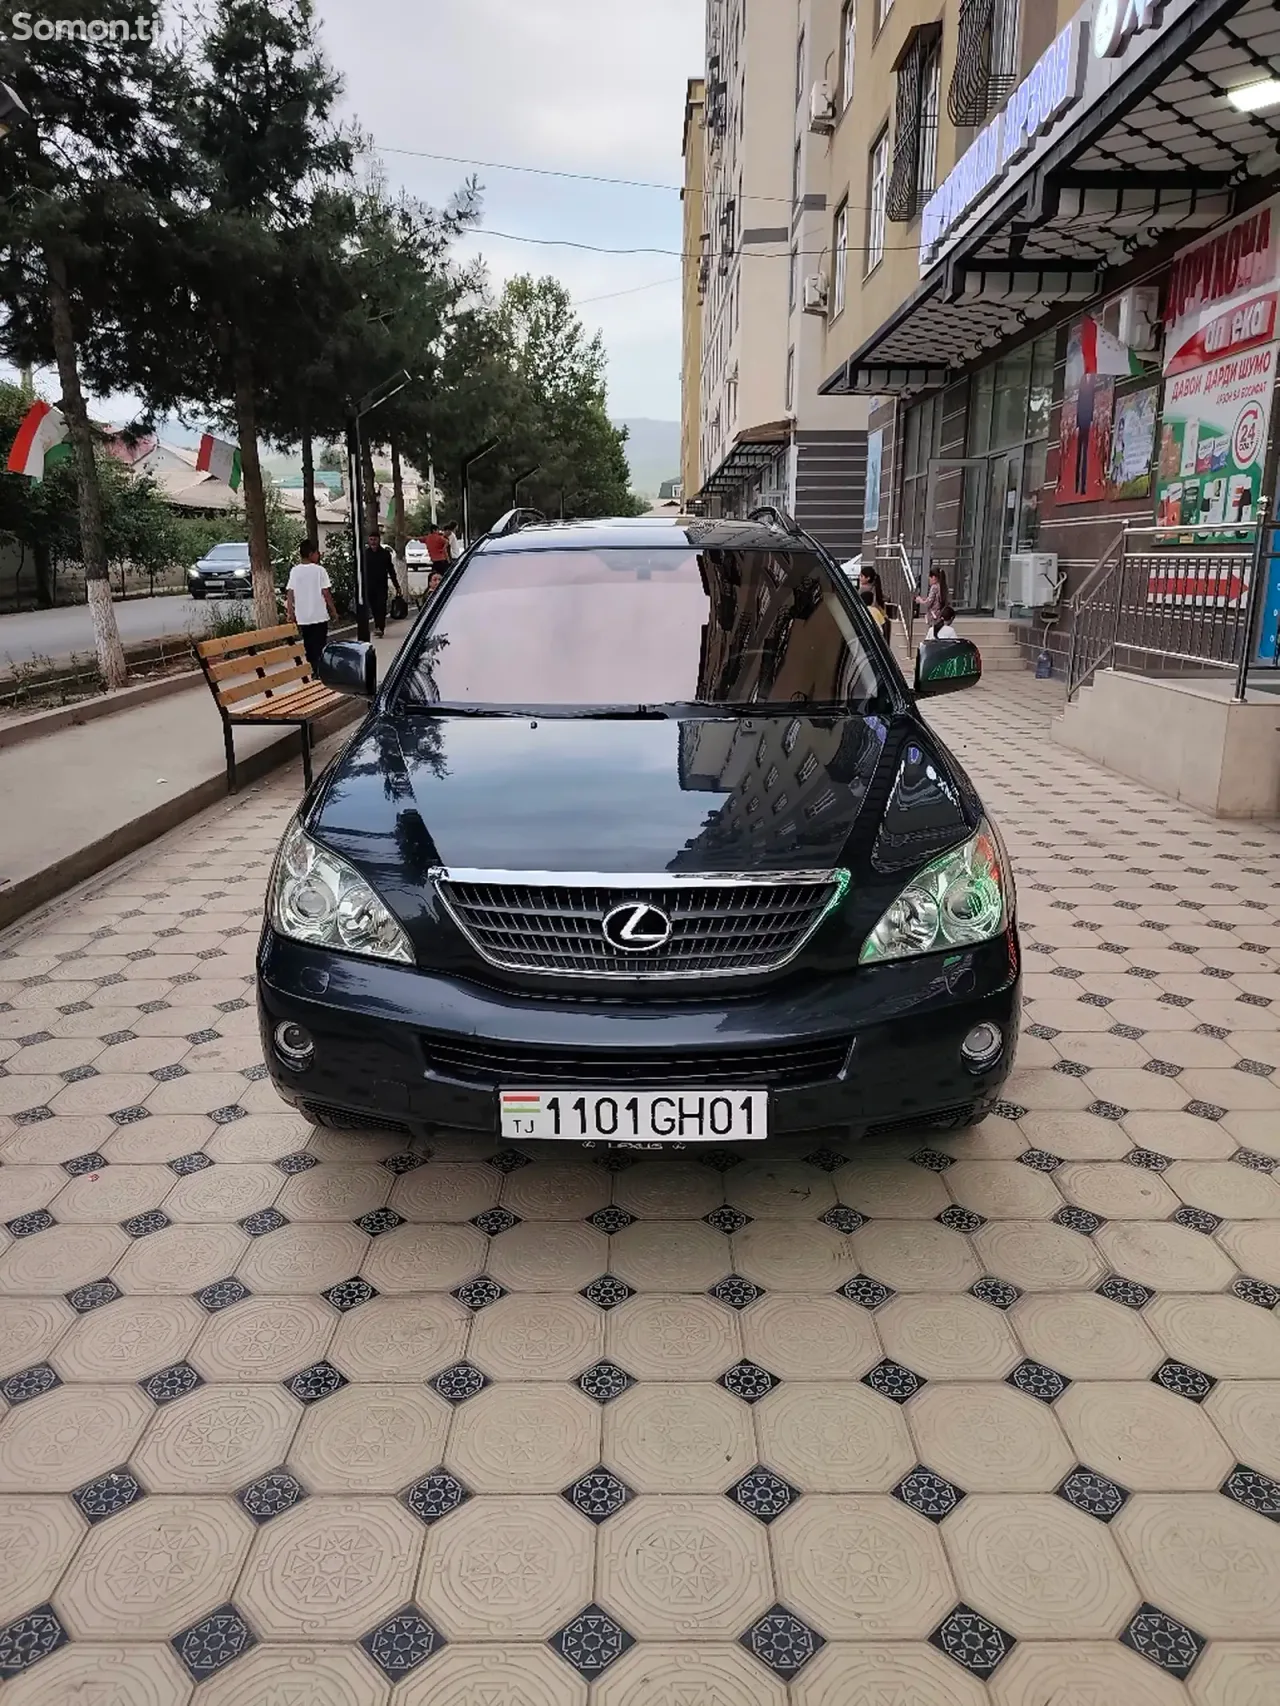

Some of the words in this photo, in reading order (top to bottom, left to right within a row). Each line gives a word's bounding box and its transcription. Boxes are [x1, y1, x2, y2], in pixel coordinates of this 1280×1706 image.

[1238, 350, 1272, 380] ШУМО
[1240, 422, 1255, 442] 24
[513, 1119, 535, 1134] TJ
[546, 1096, 753, 1135] 1101GH01
